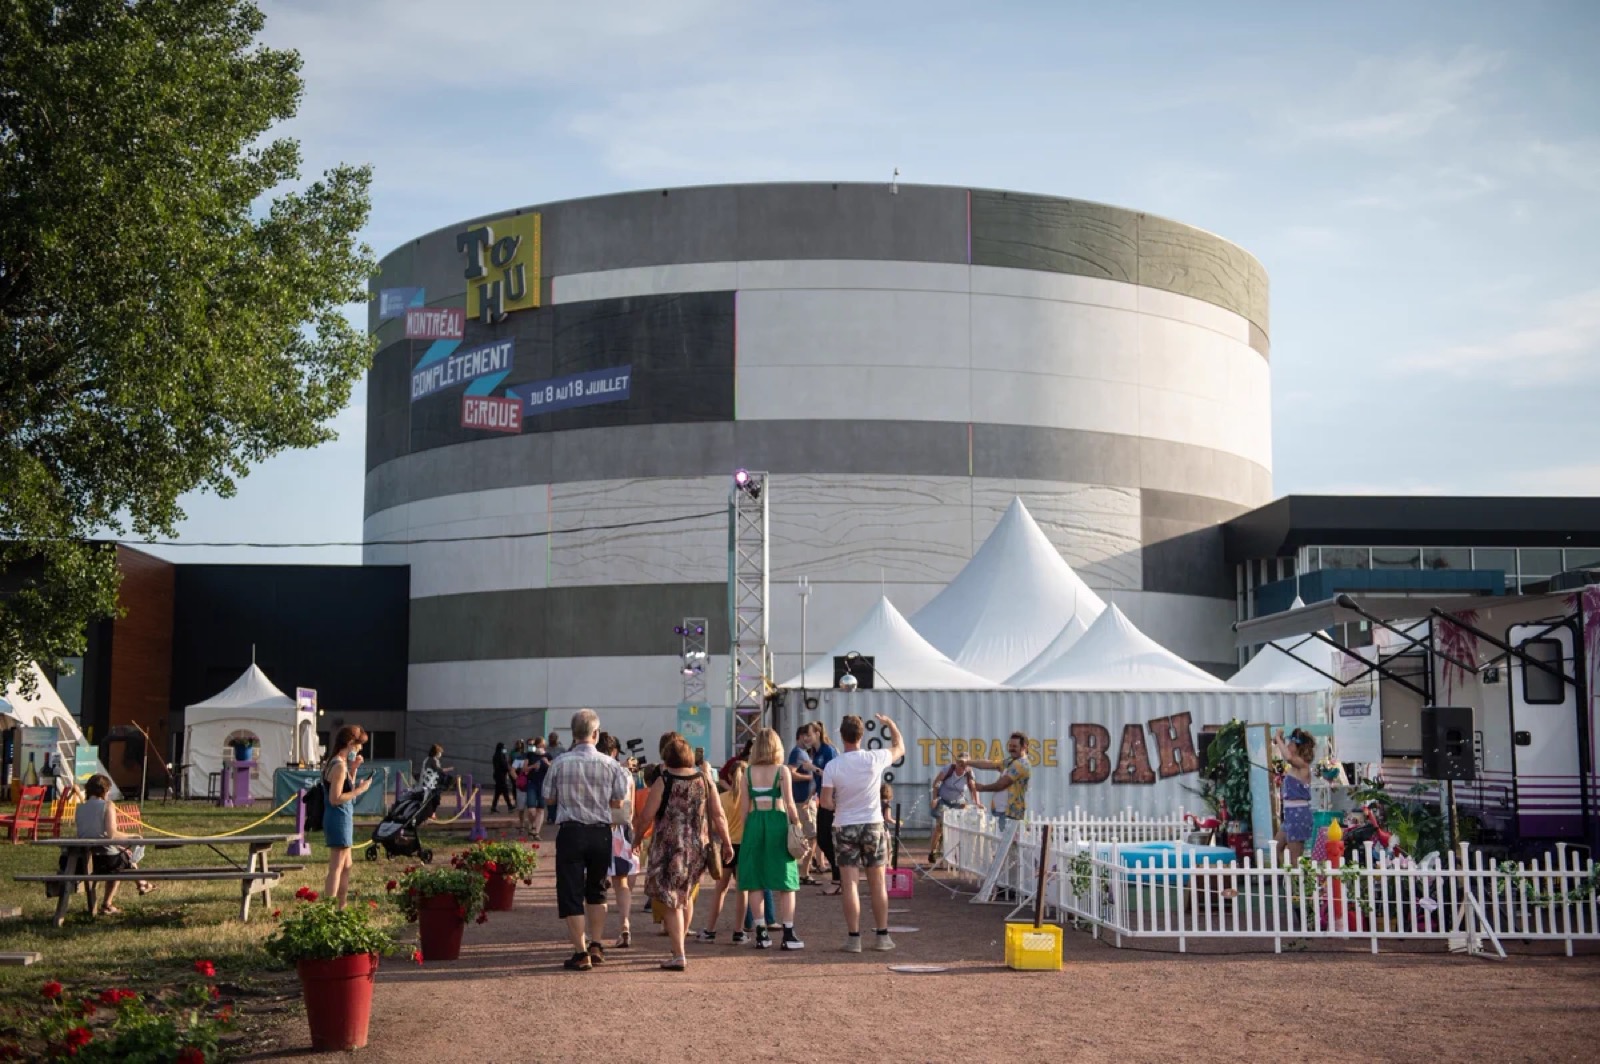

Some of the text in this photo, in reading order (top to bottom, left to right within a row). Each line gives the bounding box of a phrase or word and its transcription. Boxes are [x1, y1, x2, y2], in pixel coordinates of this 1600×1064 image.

[406, 309, 462, 337] MONTRÉAL
[531, 391, 543, 405] DU
[545, 386, 553, 401] 8
[585, 376, 628, 395] JUILLET
[917, 711, 1221, 785] TERRASE BAH
